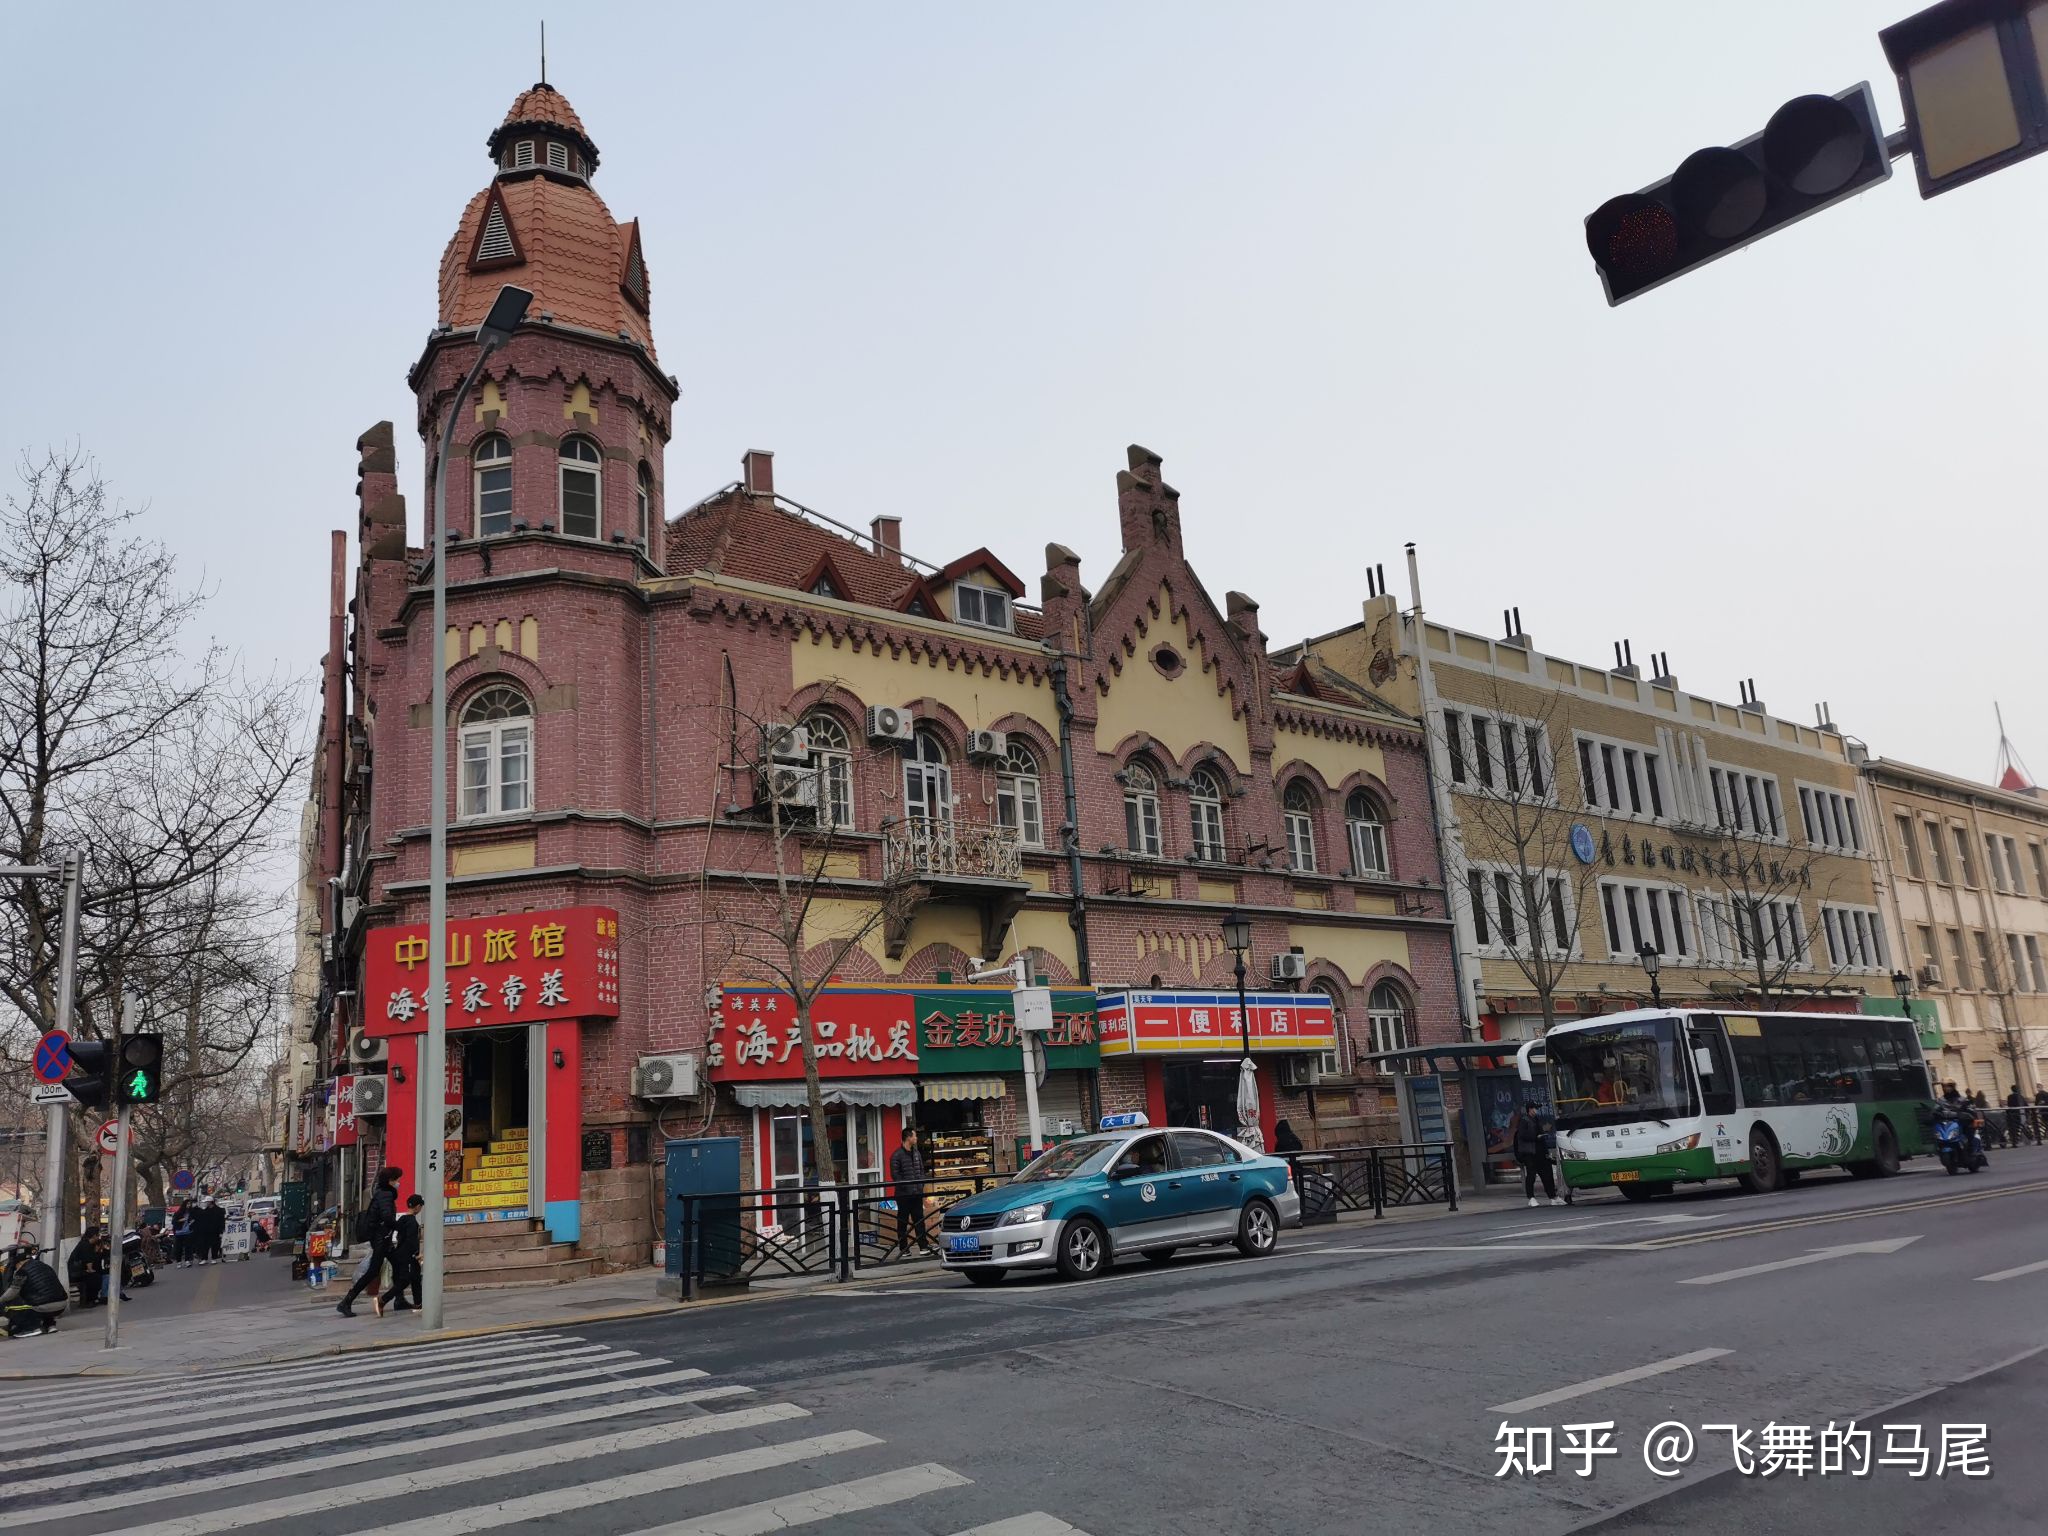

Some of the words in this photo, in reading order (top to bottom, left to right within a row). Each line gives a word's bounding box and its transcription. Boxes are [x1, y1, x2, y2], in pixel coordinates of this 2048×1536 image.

[395, 922, 567, 971] 中山旅馆
[922, 1009, 1097, 1048] 金麦坊豆酥
[1098, 1016, 1127, 1034] 便利店
[1188, 1008, 1288, 1034] 便利店
[735, 1017, 920, 1066] 海产品批发
[41, 1085, 63, 1095] 100m
[338, 1085, 356, 1132] 烧烤
[1105, 1114, 1132, 1127] 大信
